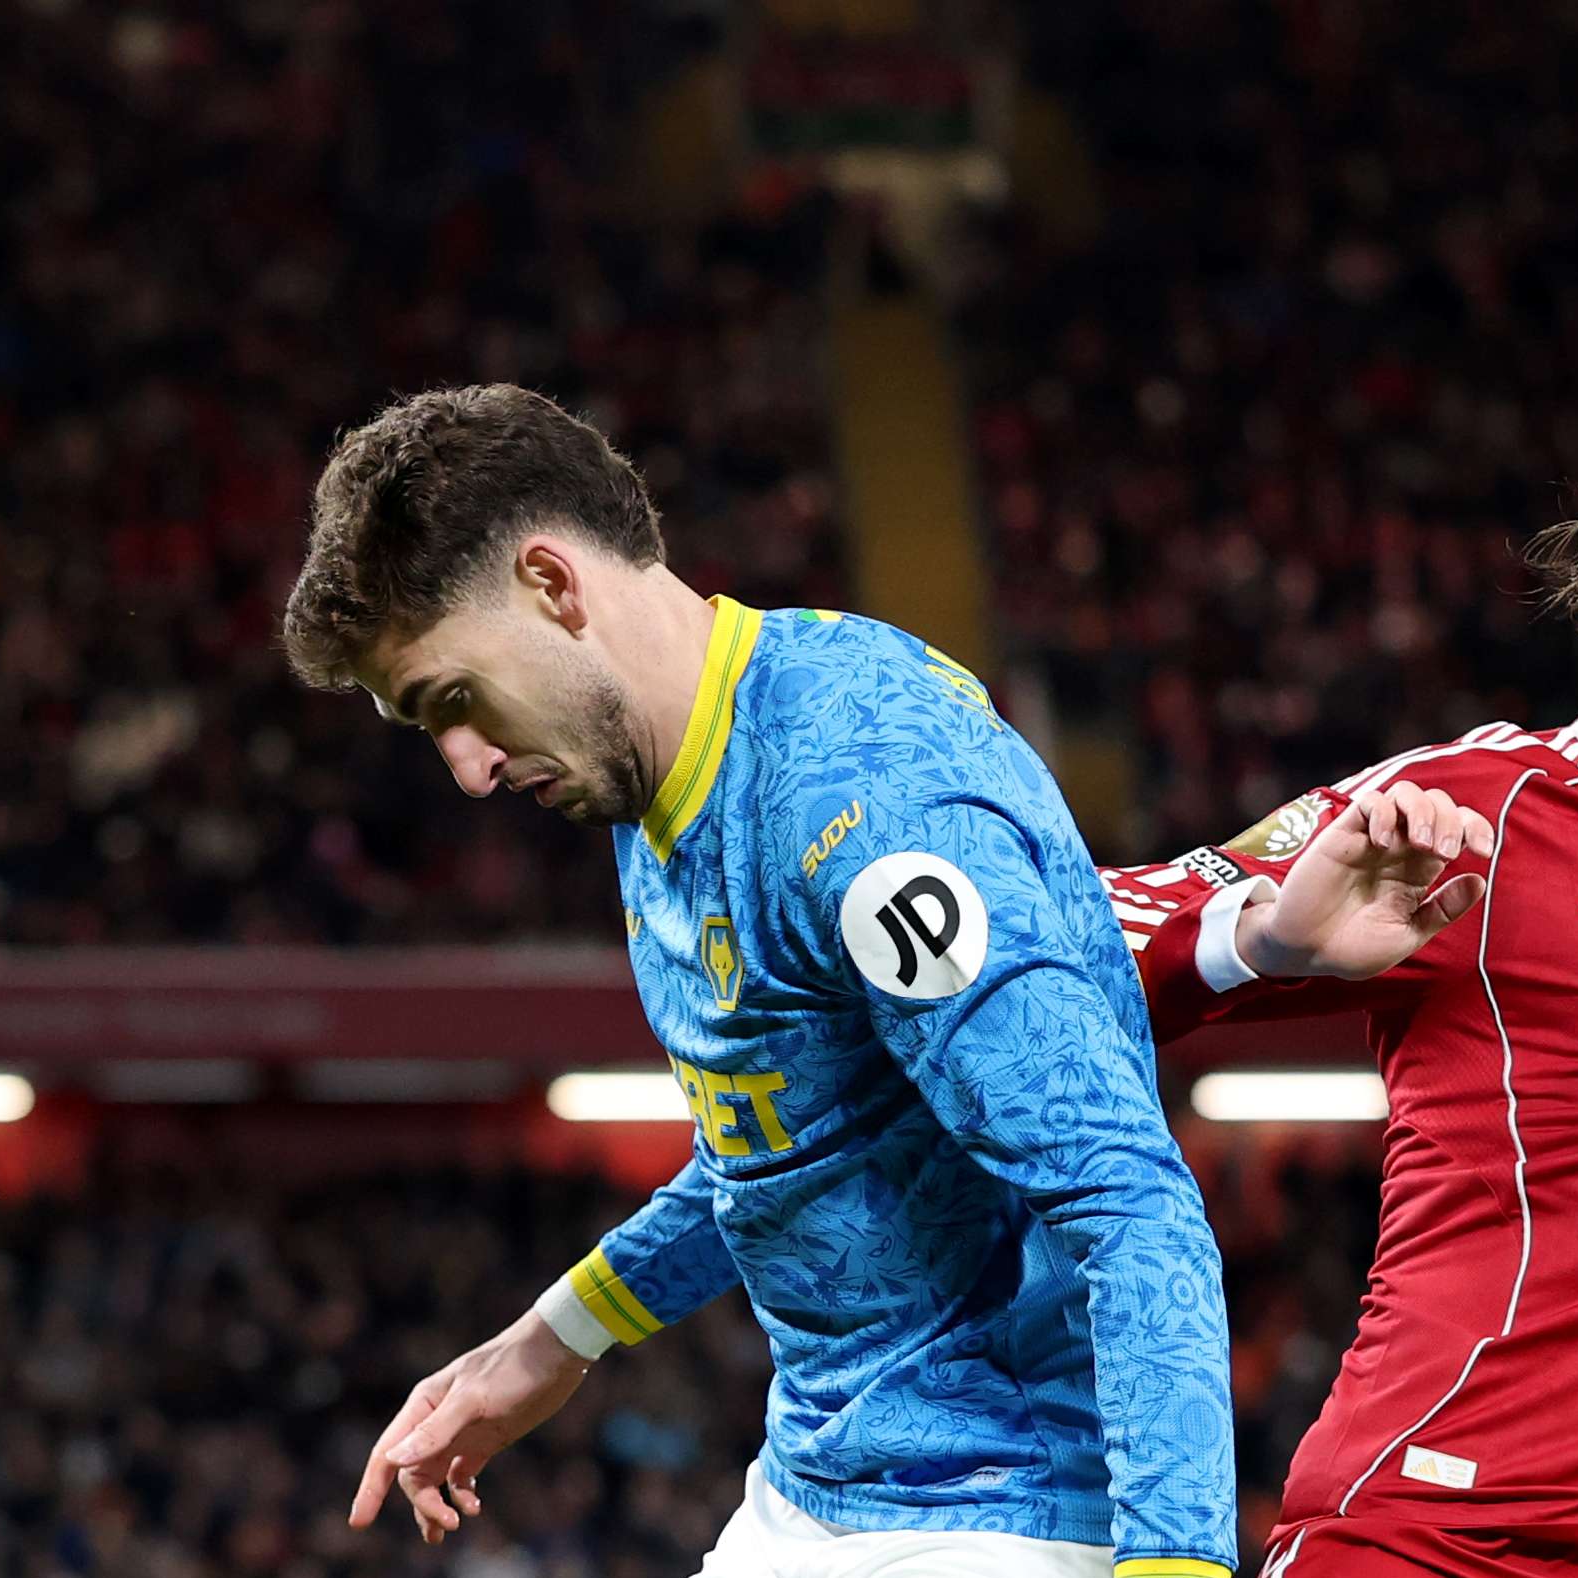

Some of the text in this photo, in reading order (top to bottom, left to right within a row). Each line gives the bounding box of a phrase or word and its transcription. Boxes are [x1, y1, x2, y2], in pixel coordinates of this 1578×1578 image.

[801, 799, 864, 880] SUDU
[1191, 847, 1239, 881] oom
[875, 874, 961, 989] JD
[668, 1052, 794, 1157] BET
